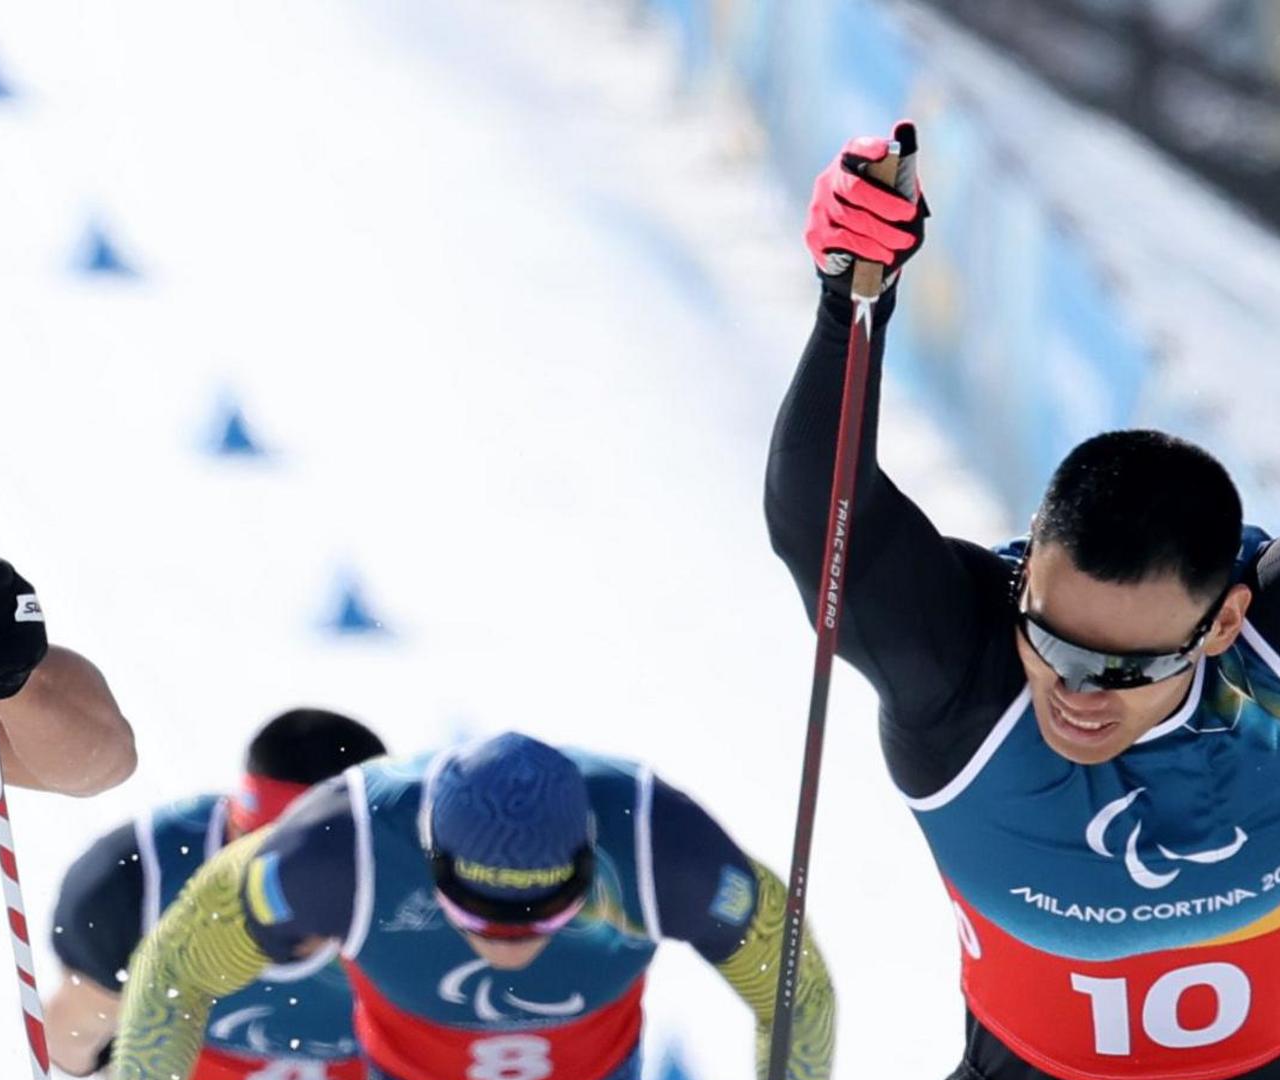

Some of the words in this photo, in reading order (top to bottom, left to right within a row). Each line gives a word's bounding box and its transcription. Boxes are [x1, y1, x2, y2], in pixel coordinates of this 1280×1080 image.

[833, 499, 850, 552] TRIAC
[824, 577, 839, 629] AERO
[1009, 886, 1128, 924] MILANO
[1131, 887, 1259, 921] CORTINA
[1070, 961, 1252, 1056] 10
